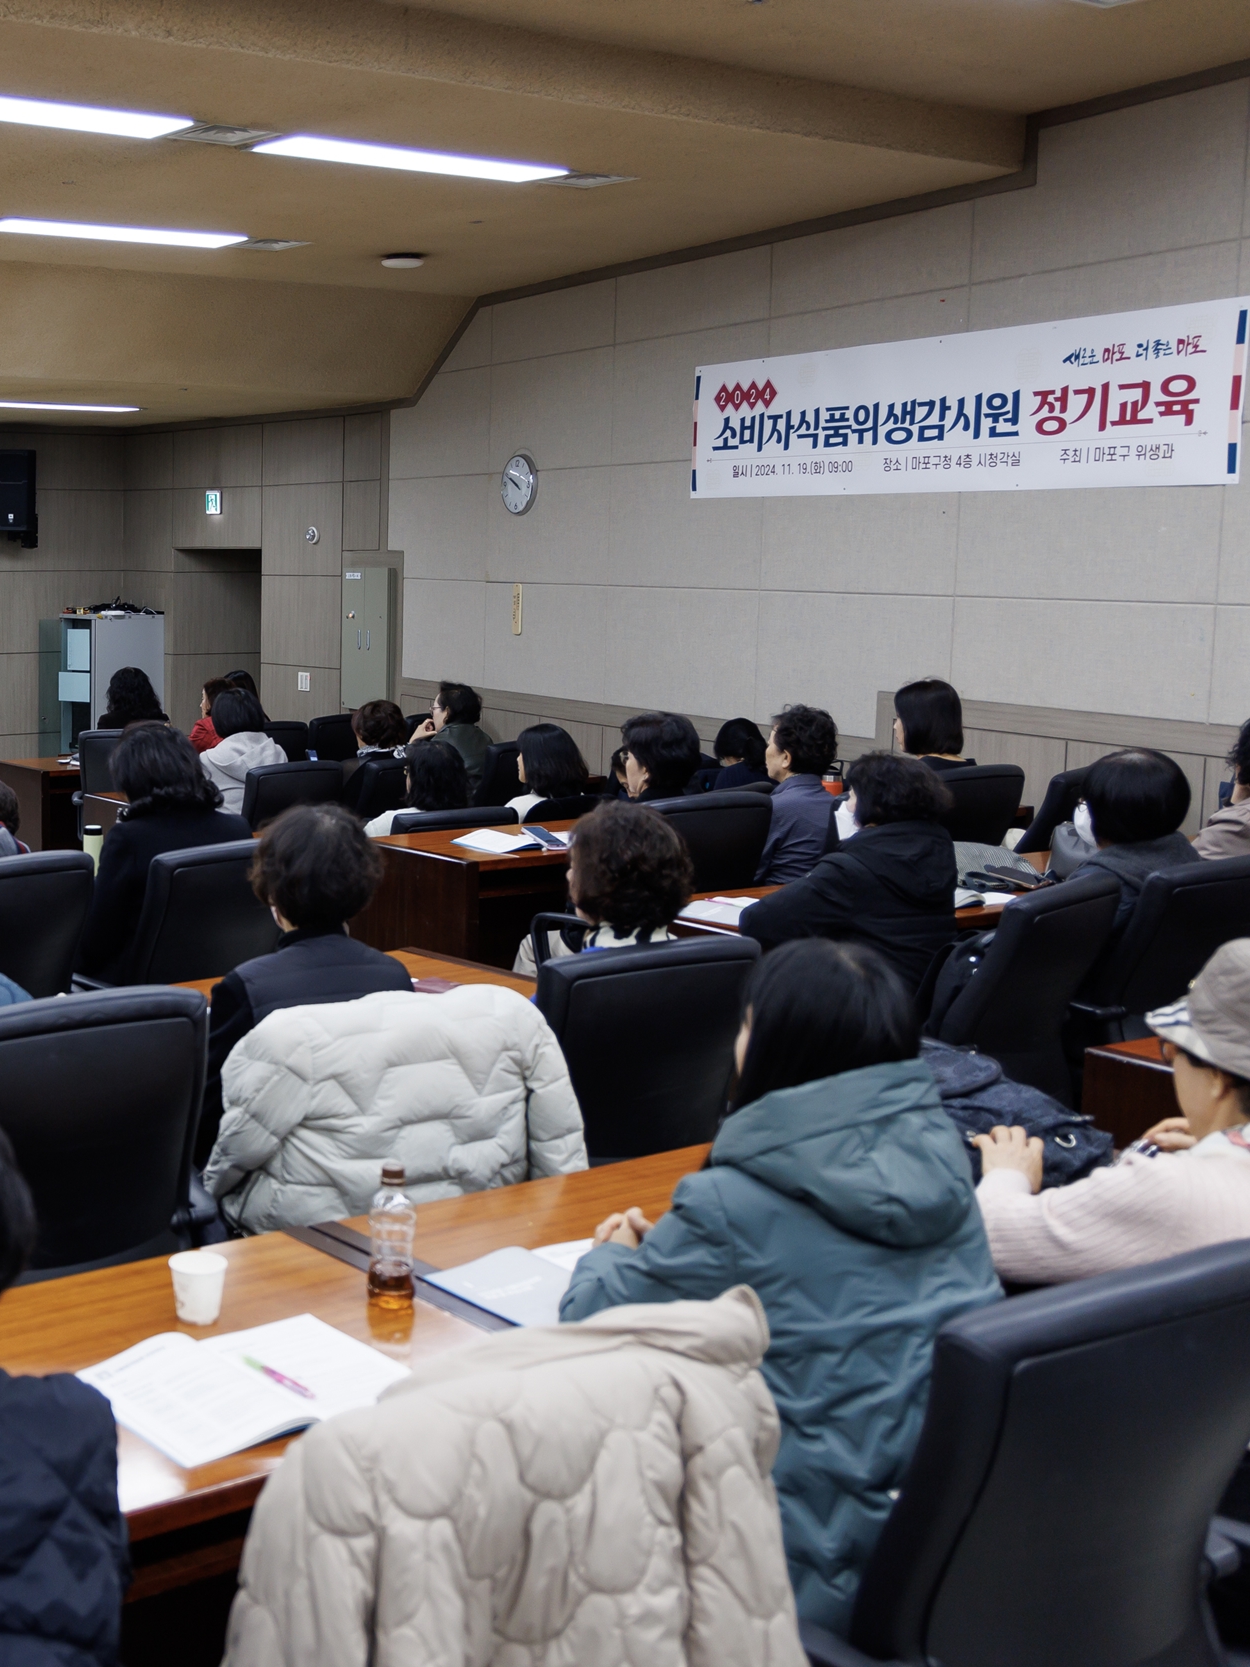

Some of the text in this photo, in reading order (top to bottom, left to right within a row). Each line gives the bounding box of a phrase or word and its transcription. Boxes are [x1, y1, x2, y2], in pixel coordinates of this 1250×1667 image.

[1062, 335, 1207, 367] 새로운 마포 더 좋은 마포
[719, 388, 771, 405] 2024
[712, 374, 1201, 452] 소비자식품위생감시원 정기교육
[883, 451, 1021, 472] 장소 마포구청 4층 시청각실
[1059, 443, 1175, 464] 주최 마포구 위생과
[732, 464, 748, 478] 일시
[755, 464, 778, 477] 2024.
[781, 463, 794, 475] 11.
[828, 461, 853, 474] 09:00
